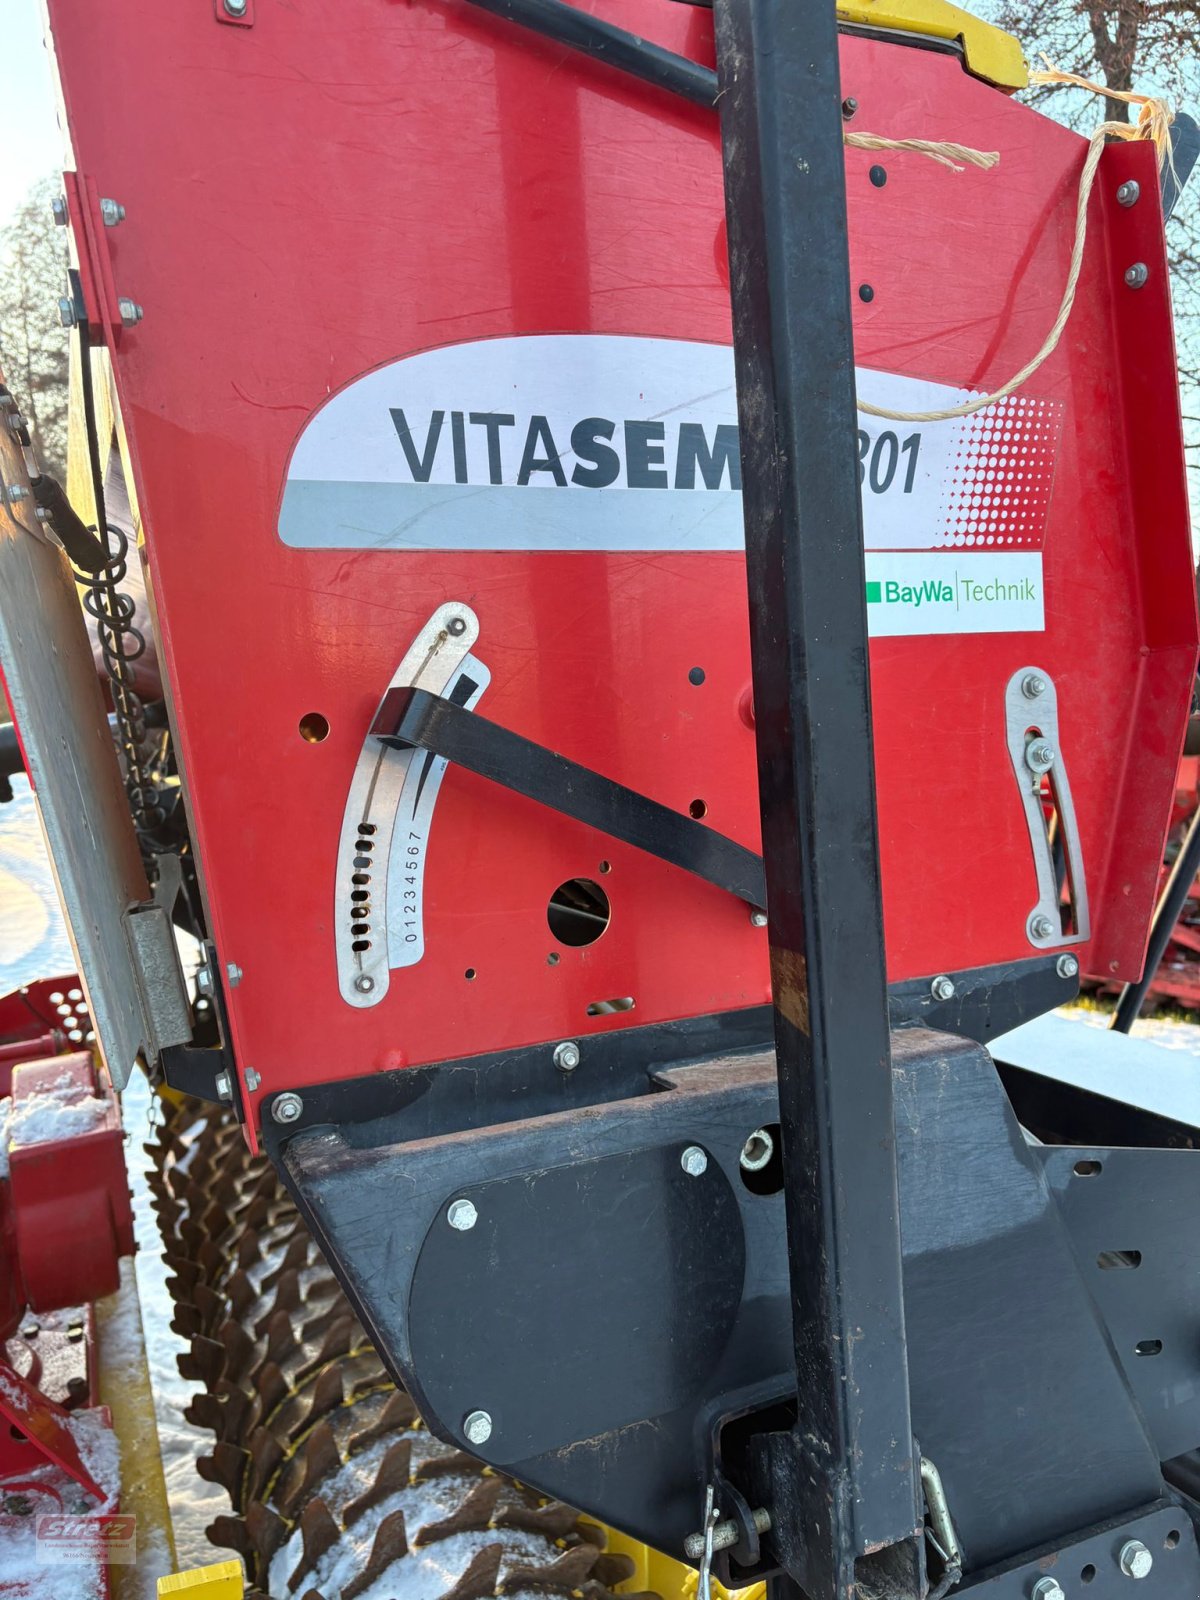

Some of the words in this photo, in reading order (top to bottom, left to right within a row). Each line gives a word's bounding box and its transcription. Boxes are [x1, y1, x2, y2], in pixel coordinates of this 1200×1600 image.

[388, 407, 743, 491] VITASEM
[885, 580, 954, 607] BayWa
[960, 577, 1036, 602] Technik
[408, 832, 421, 840] 7
[407, 846, 420, 855] 6
[405, 861, 418, 870] 5
[404, 876, 416, 885] 4
[403, 890, 416, 899] 3
[403, 905, 416, 914] 2
[405, 934, 417, 943] 0
